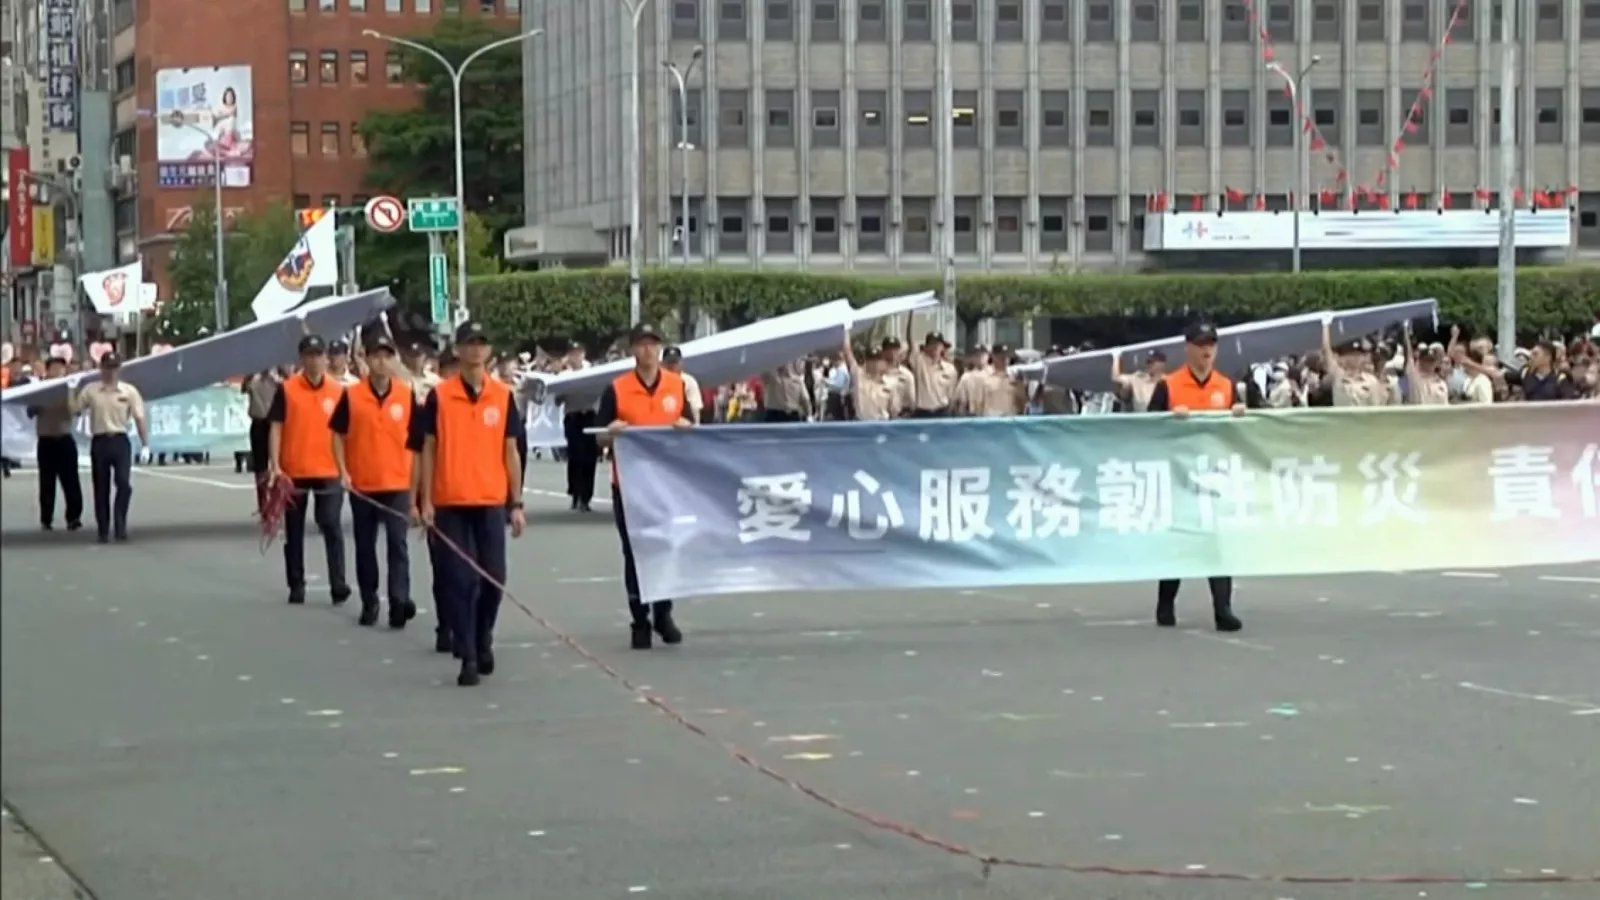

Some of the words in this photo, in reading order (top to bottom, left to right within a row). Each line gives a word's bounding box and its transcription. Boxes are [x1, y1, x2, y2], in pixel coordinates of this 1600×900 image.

[737, 451, 1428, 544] 愛心服務韌性防災
